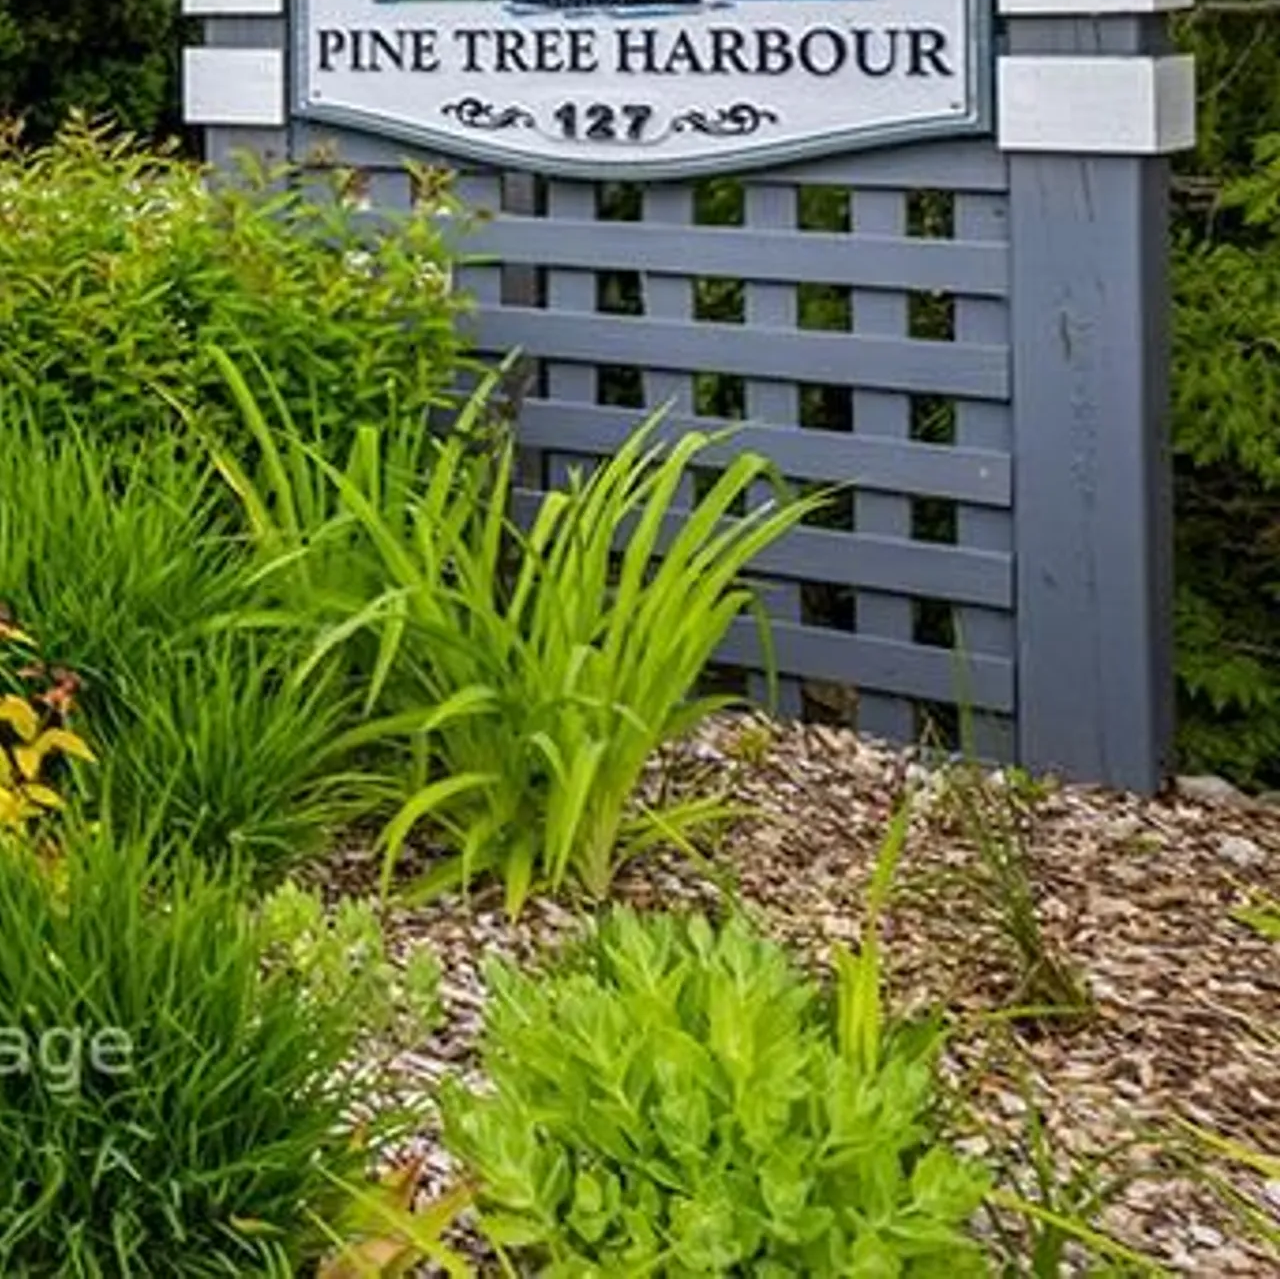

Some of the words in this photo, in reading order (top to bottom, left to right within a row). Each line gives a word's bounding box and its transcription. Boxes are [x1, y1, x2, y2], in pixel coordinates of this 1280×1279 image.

[317, 28, 440, 73] PINE
[454, 28, 598, 73] TREE
[616, 27, 954, 76] HARBOUR
[554, 104, 650, 140] 127
